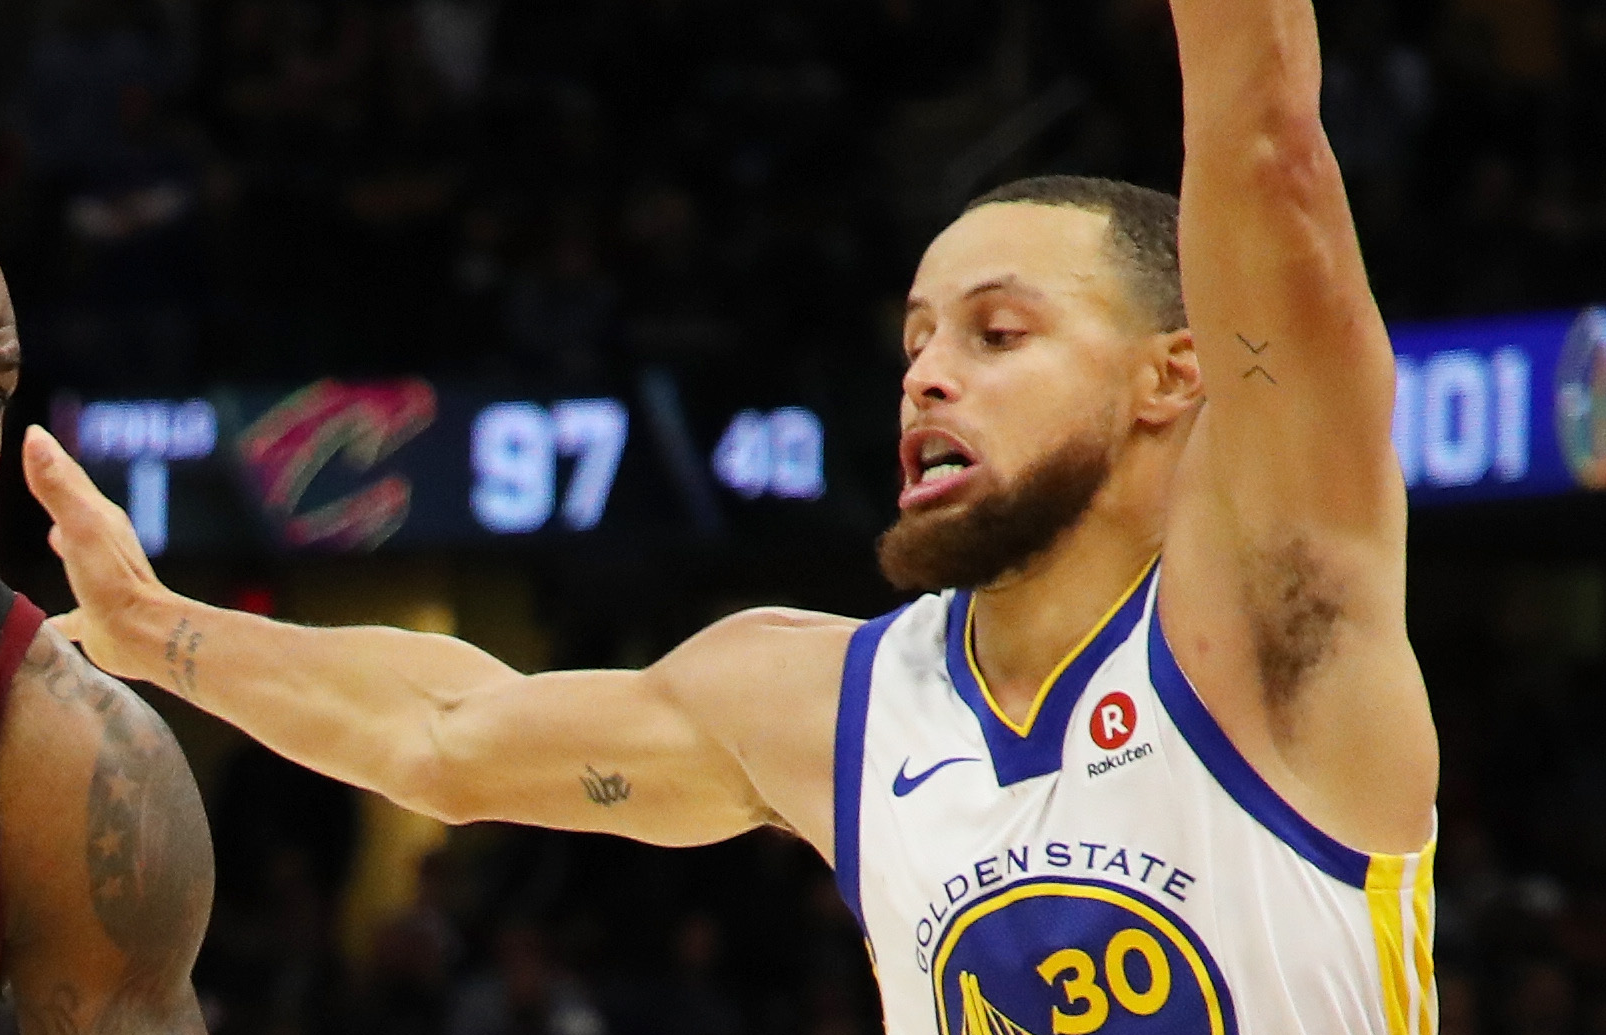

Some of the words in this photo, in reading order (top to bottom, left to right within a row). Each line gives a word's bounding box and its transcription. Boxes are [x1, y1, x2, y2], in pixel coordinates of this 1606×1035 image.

[469, 397, 629, 534] 97
[1087, 742, 1153, 778] Rakuten
[915, 846, 1030, 974] GOLDEN
[1045, 842, 1196, 903] STATE
[1036, 927, 1172, 1035] 30
